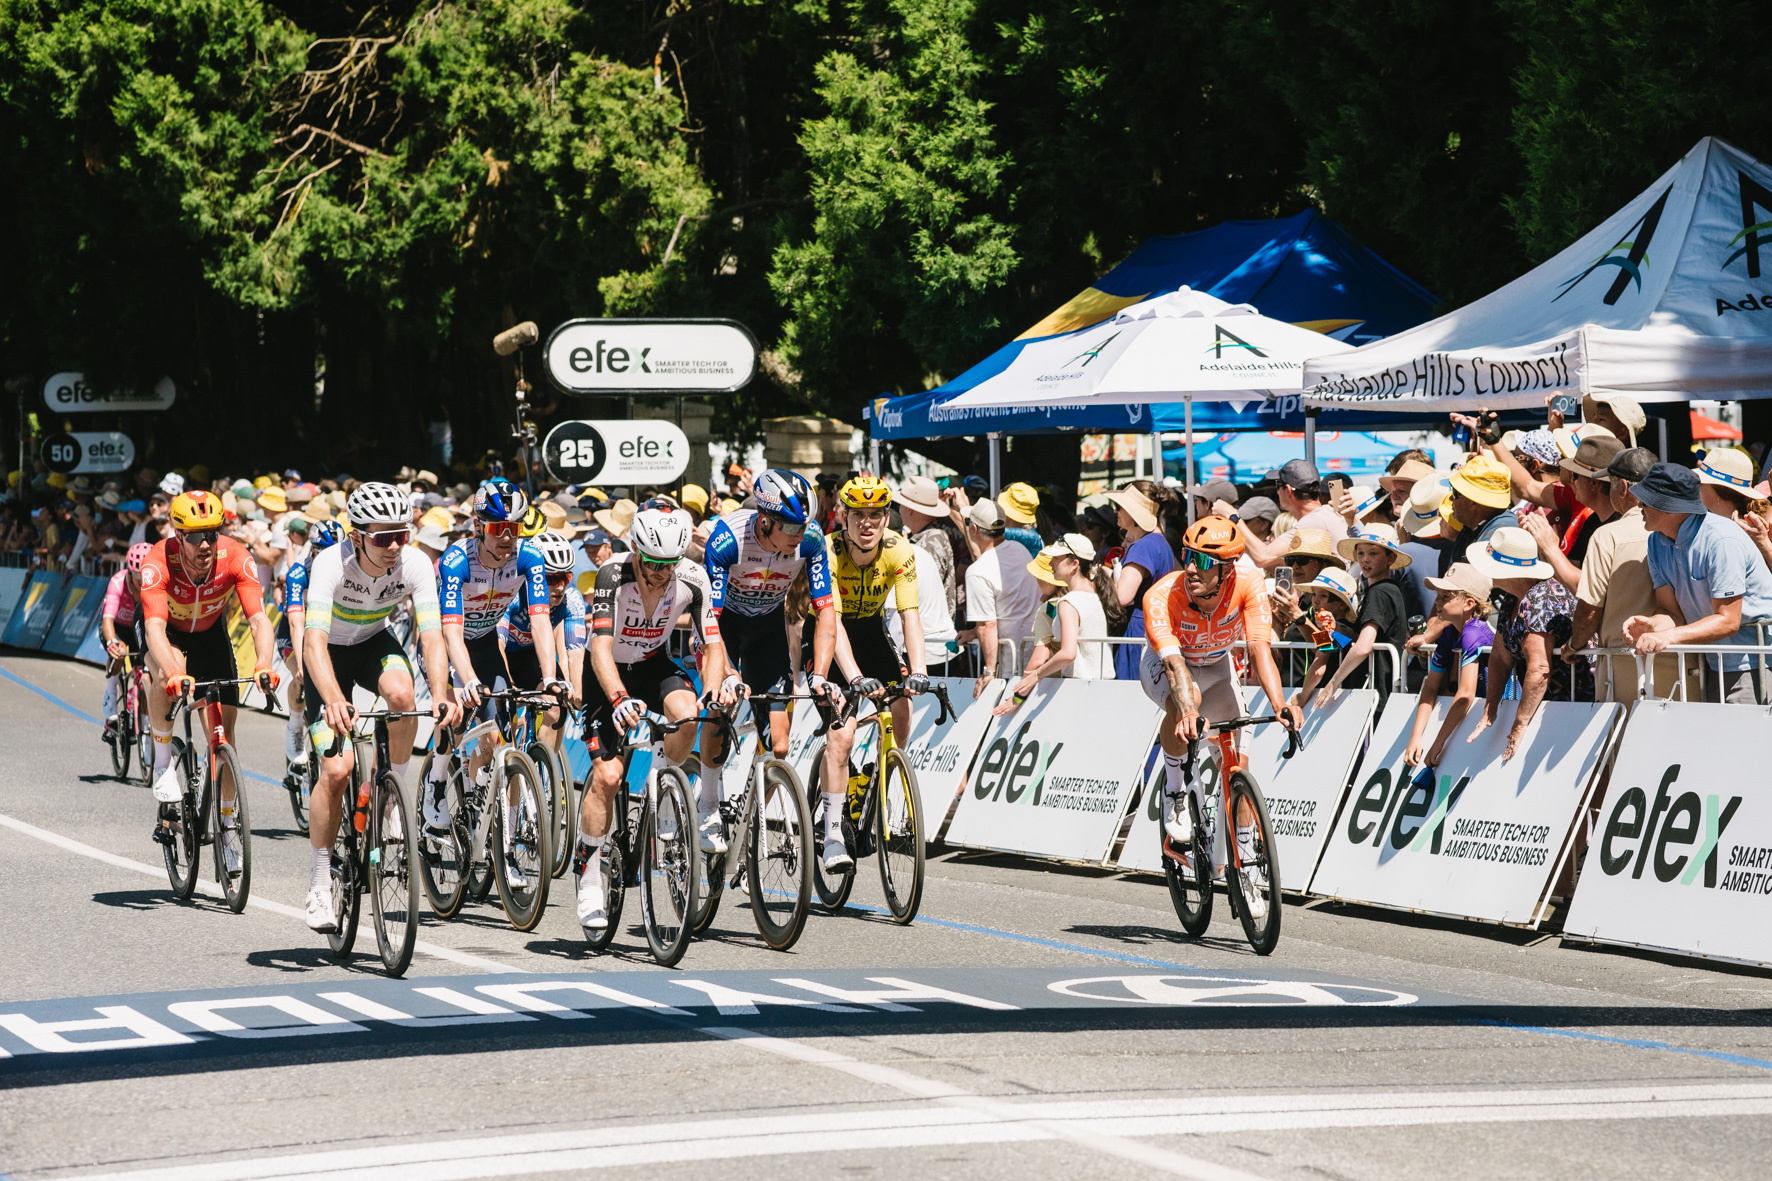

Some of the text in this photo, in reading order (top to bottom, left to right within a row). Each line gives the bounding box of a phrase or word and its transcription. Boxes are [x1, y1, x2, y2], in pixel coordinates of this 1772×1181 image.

[569, 340, 651, 374] efex
[1200, 361, 1301, 371] Adelaide Hills
[1412, 353, 1465, 397] Hills
[1472, 342, 1569, 395] Council
[56, 381, 111, 403] efe
[51, 445, 74, 462] 50
[88, 441, 124, 457] efex
[559, 439, 595, 468] 25
[619, 436, 674, 458] efex
[711, 530, 732, 548] BORA
[443, 549, 462, 567] BORA
[531, 564, 545, 598] BOSS
[681, 574, 704, 586] Analog
[852, 583, 889, 596] VISMA
[445, 575, 460, 608] BOSS
[1253, 577, 1272, 624] INEOS
[464, 607, 508, 620] ORA
[625, 616, 670, 628] UAE
[1150, 597, 1173, 641] INEOS
[626, 629, 662, 637] Emirates
[930, 744, 961, 773] Hills
[975, 721, 1064, 807] efex
[1049, 776, 1119, 796] SMARTER TECH FOR
[1041, 793, 1118, 813] AMBITIOUS BUSINESS
[1274, 799, 1299, 816] TECH
[1296, 800, 1317, 817] FOR
[1347, 764, 1471, 855] efex
[1274, 819, 1317, 838] BUSINESS
[1452, 818, 1550, 844] SMARTER TECH FOR
[1600, 763, 1743, 889] efex
[1442, 839, 1549, 866] AMBITIOUS BUSINESS
[1728, 845, 1772, 870] SMART
[0, 976, 1022, 1058] HYUNDA
